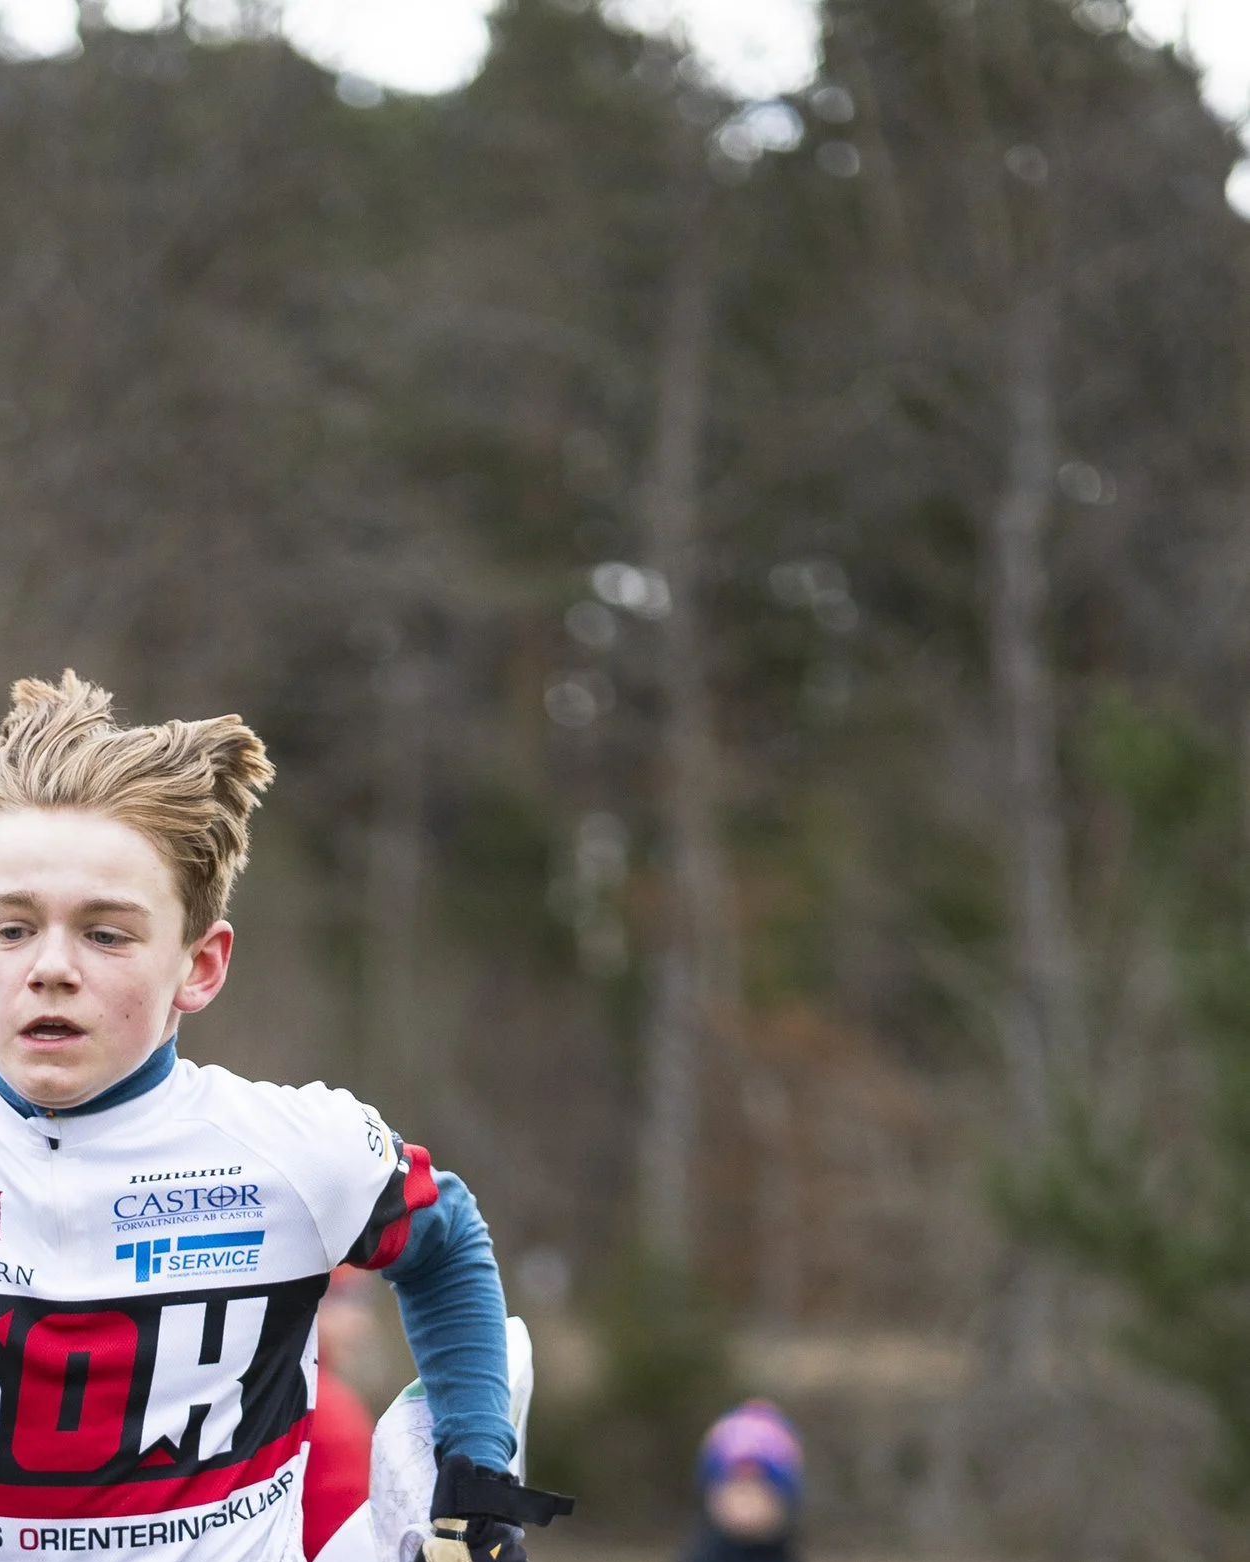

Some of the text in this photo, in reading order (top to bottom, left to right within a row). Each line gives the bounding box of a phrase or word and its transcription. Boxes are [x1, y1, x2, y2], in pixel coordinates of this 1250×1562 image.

[129, 1165, 243, 1185] noname
[113, 1184, 263, 1220] CASTOR
[202, 1212, 217, 1222] AB
[220, 1210, 264, 1221] CASTOR
[168, 1249, 261, 1271] SERVICE
